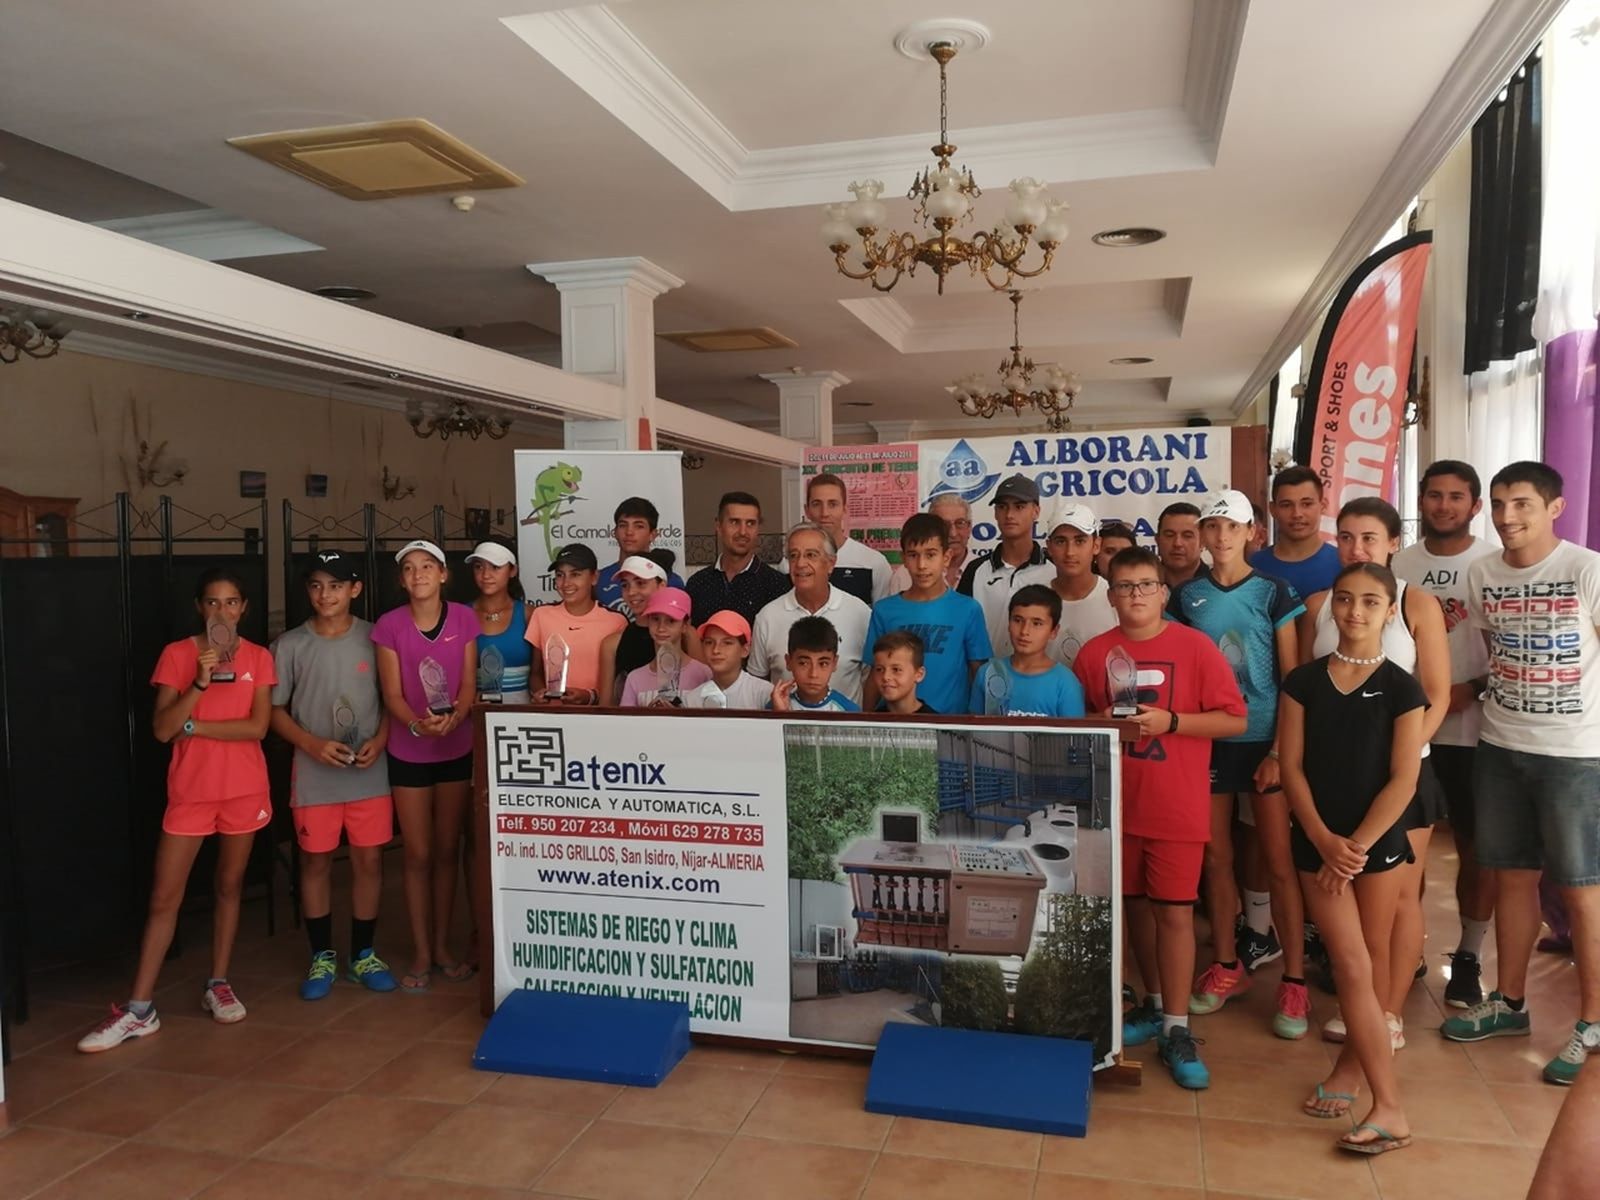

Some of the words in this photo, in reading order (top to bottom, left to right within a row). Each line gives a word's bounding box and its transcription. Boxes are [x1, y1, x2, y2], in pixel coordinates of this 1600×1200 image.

[1328, 361, 1348, 416] SHOES
[1324, 419, 1339, 432] &
[1006, 433, 1208, 466] ALBORANI
[1320, 437, 1337, 488] SPORT
[946, 460, 980, 477] aa
[1034, 466, 1208, 497] GRICOLA
[551, 524, 563, 538] El
[1421, 570, 1458, 585] ADI
[567, 752, 667, 791] atenix
[498, 794, 601, 811] ELECTRONICA
[609, 798, 619, 811] Y
[621, 798, 727, 816] AUTOMATICA,
[732, 803, 760, 817] S.L.
[498, 816, 527, 830] Telf.
[531, 817, 557, 831] 950
[561, 819, 586, 833] 207
[590, 820, 616, 834] 234
[628, 821, 668, 837] Móvil
[672, 824, 698, 838] 629
[703, 825, 730, 840] 278
[735, 827, 762, 842] 735
[497, 843, 517, 858] Pol.
[519, 844, 539, 859] ind.
[541, 844, 564, 860] LOS
[567, 845, 619, 865] GRILLOS,
[621, 847, 642, 865] San
[644, 849, 679, 869] Isidro,
[538, 868, 720, 894] www.atenix.com
[526, 908, 598, 940] SISTEMAS
[602, 914, 621, 941] DE
[626, 915, 671, 945] RIEGO
[675, 918, 688, 945] Y
[690, 920, 737, 950] CLIMA
[513, 942, 632, 978] HUMIDIFICACION
[636, 950, 648, 978] Y
[651, 951, 754, 988] SULFATACION
